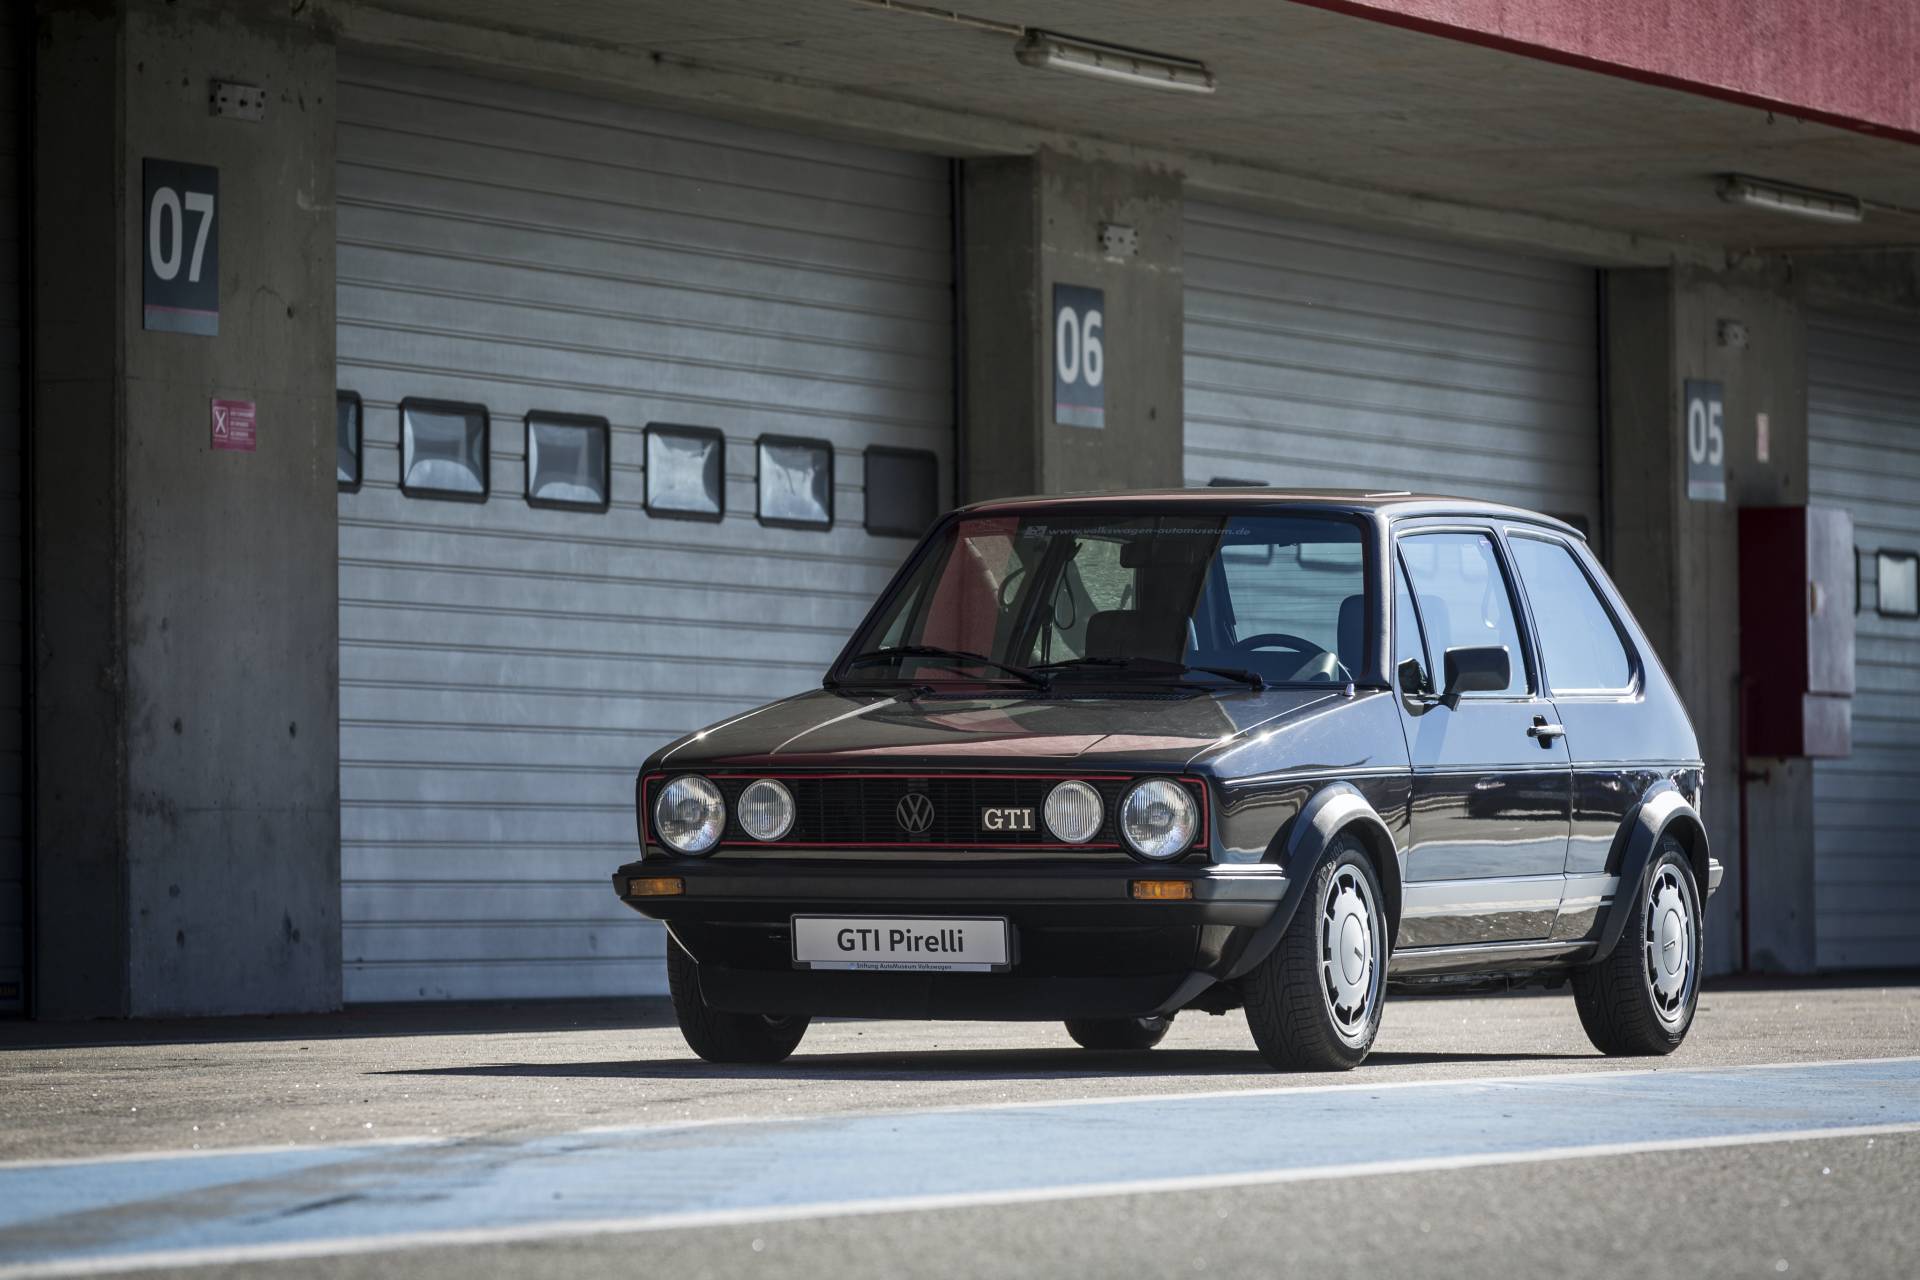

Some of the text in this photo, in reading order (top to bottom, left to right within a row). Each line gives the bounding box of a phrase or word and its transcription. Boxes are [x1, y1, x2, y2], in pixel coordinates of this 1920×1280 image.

[150, 186, 214, 282] 07
[1056, 306, 1104, 387] 06
[1688, 398, 1724, 465] 05
[984, 808, 1031, 829] GTI
[837, 928, 963, 952] GTI Pirelli
[857, 962, 879, 970] Stiftung
[918, 963, 952, 971] Volkswagen
